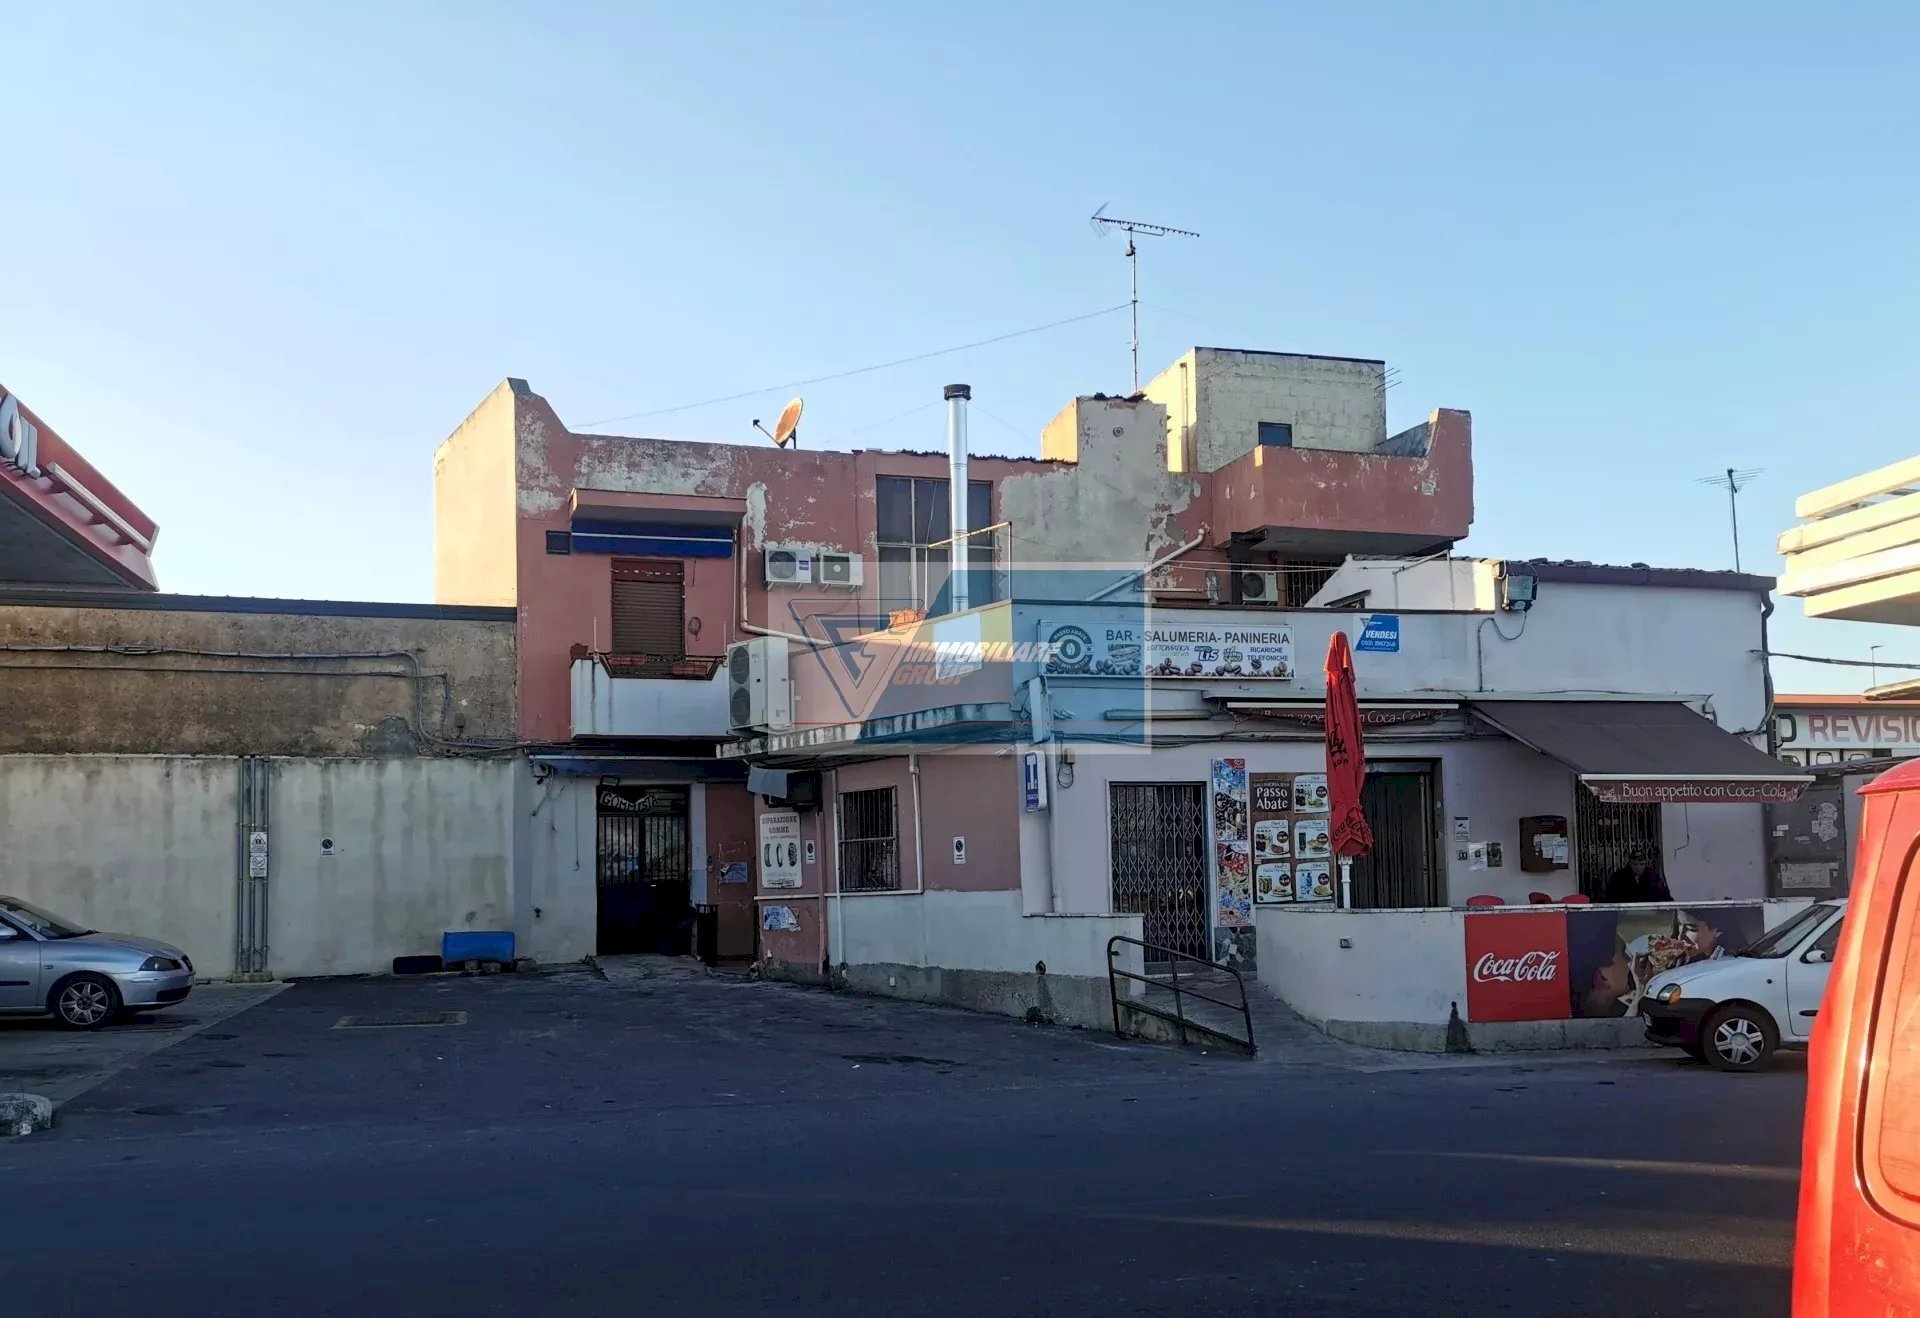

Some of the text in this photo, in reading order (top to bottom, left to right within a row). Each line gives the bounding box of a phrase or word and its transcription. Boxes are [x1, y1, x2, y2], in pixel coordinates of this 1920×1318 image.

[1106, 629, 1132, 641] BAR
[1224, 632, 1290, 644] PANINERIA
[1365, 630, 1397, 640] VENDESI
[1256, 787, 1288, 798] Passo
[1622, 782, 1787, 800] Buon appetito con Coca-Cola
[600, 790, 659, 812] GOMMISTA
[1256, 798, 1289, 810] Abate
[768, 826, 790, 834] GOMME
[1473, 951, 1560, 983] Coca-Cola
